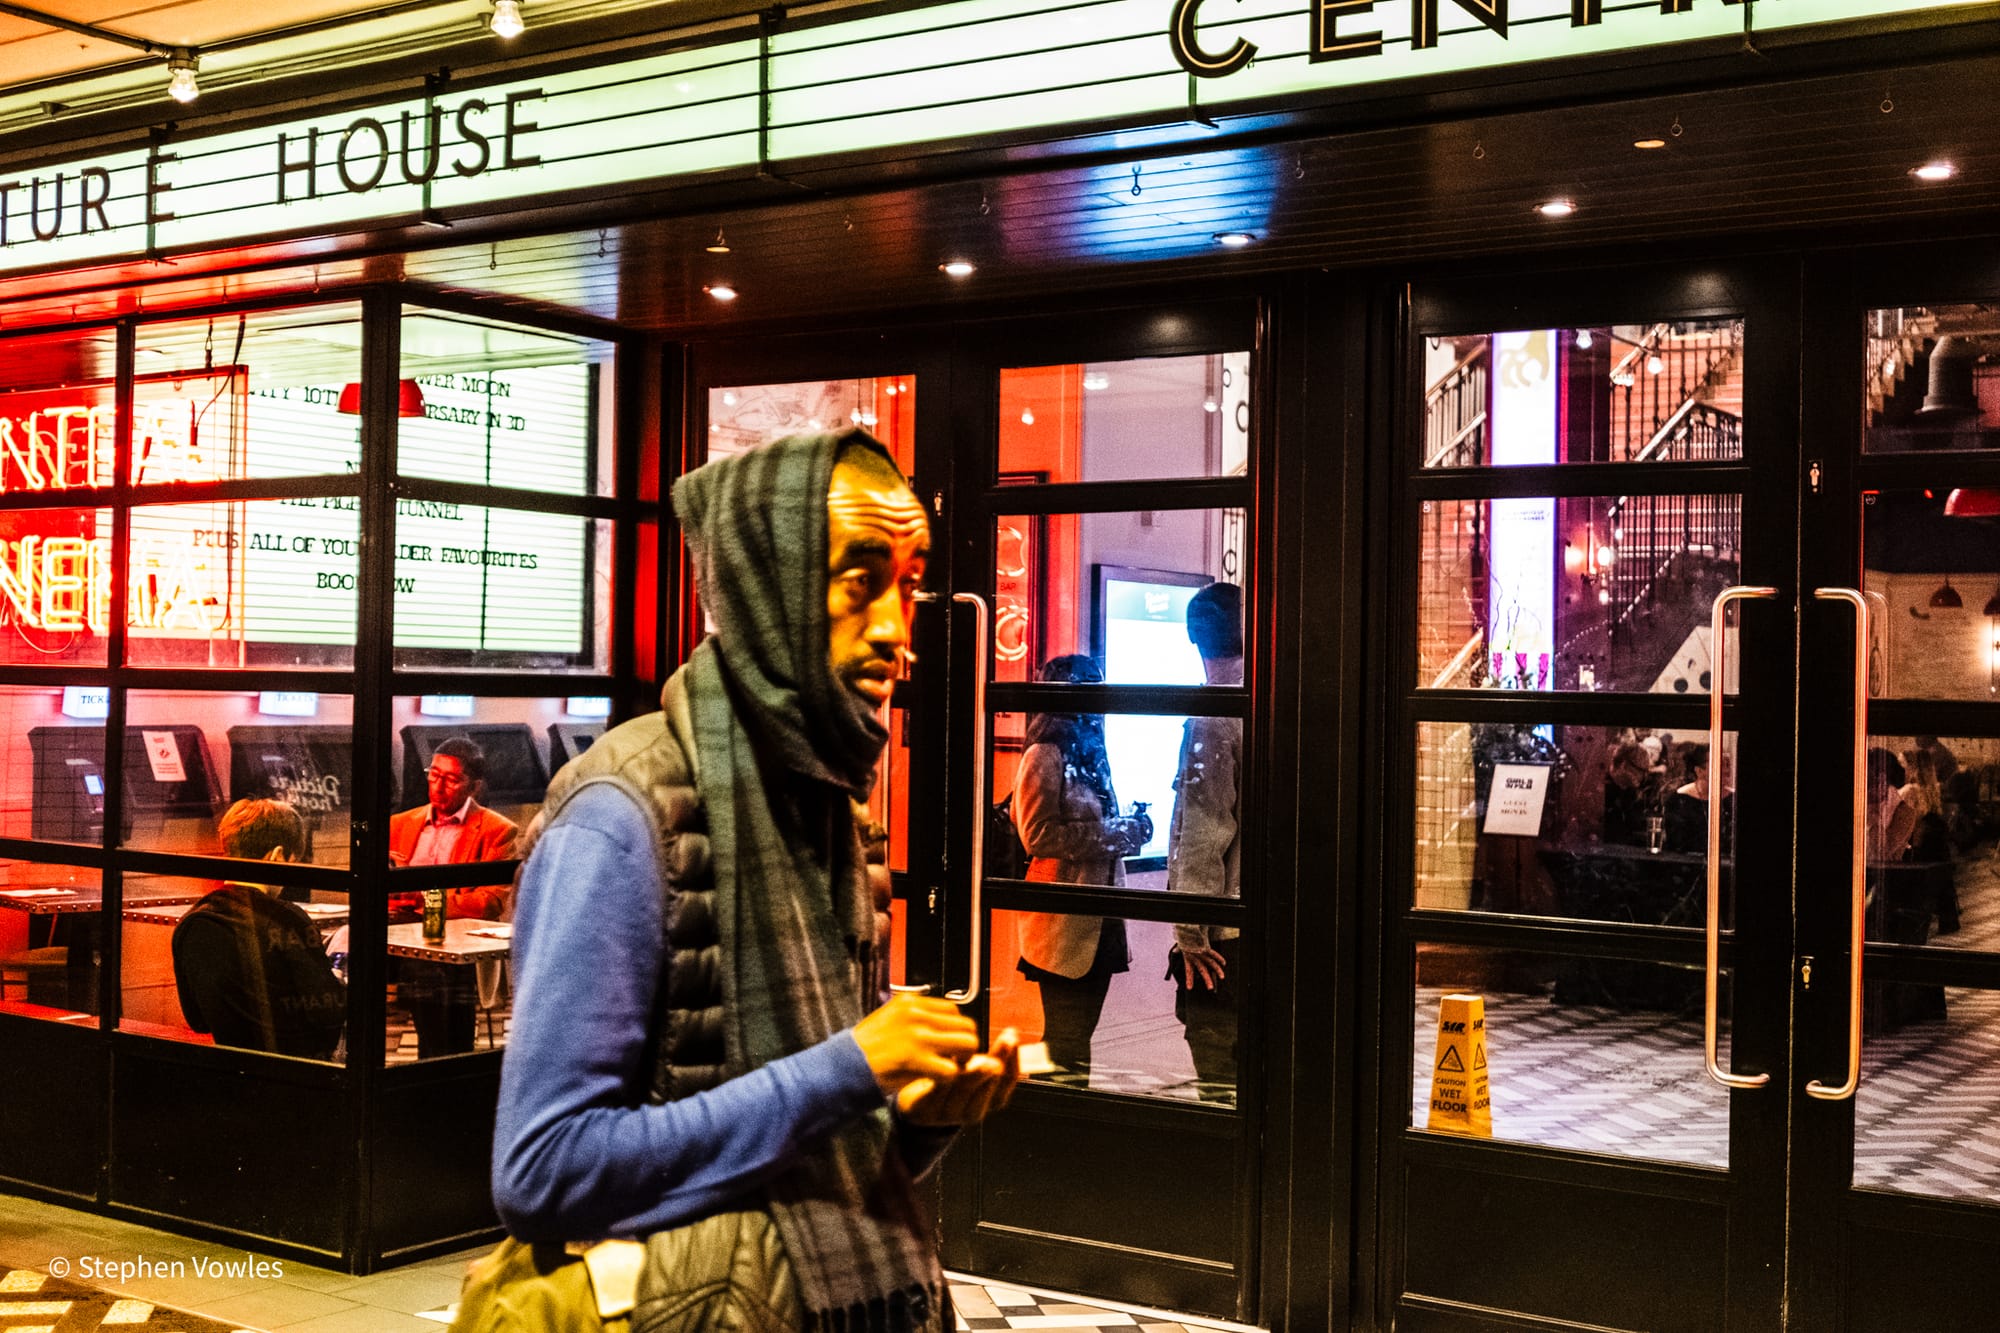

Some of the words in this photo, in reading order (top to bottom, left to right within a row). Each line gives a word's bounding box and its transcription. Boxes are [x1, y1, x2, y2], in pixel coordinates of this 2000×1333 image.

[278, 87, 545, 204] HOUSE
[461, 377, 511, 397] MOON
[425, 404, 480, 425] RSARY
[506, 415, 526, 431] 3D
[398, 501, 464, 520] TUNNEL
[193, 529, 239, 549] PLUS
[250, 533, 288, 552] ALL
[292, 537, 317, 553] OF
[321, 538, 358, 557] YOU
[396, 544, 433, 562] DER
[440, 547, 539, 570] FAVOURITES
[316, 572, 355, 591] BOO
[81, 695, 110, 704] TICK
[1435, 1077, 1466, 1087] CAUTION
[1440, 1087, 1462, 1099] WET
[1432, 1100, 1467, 1113] FLOOR
